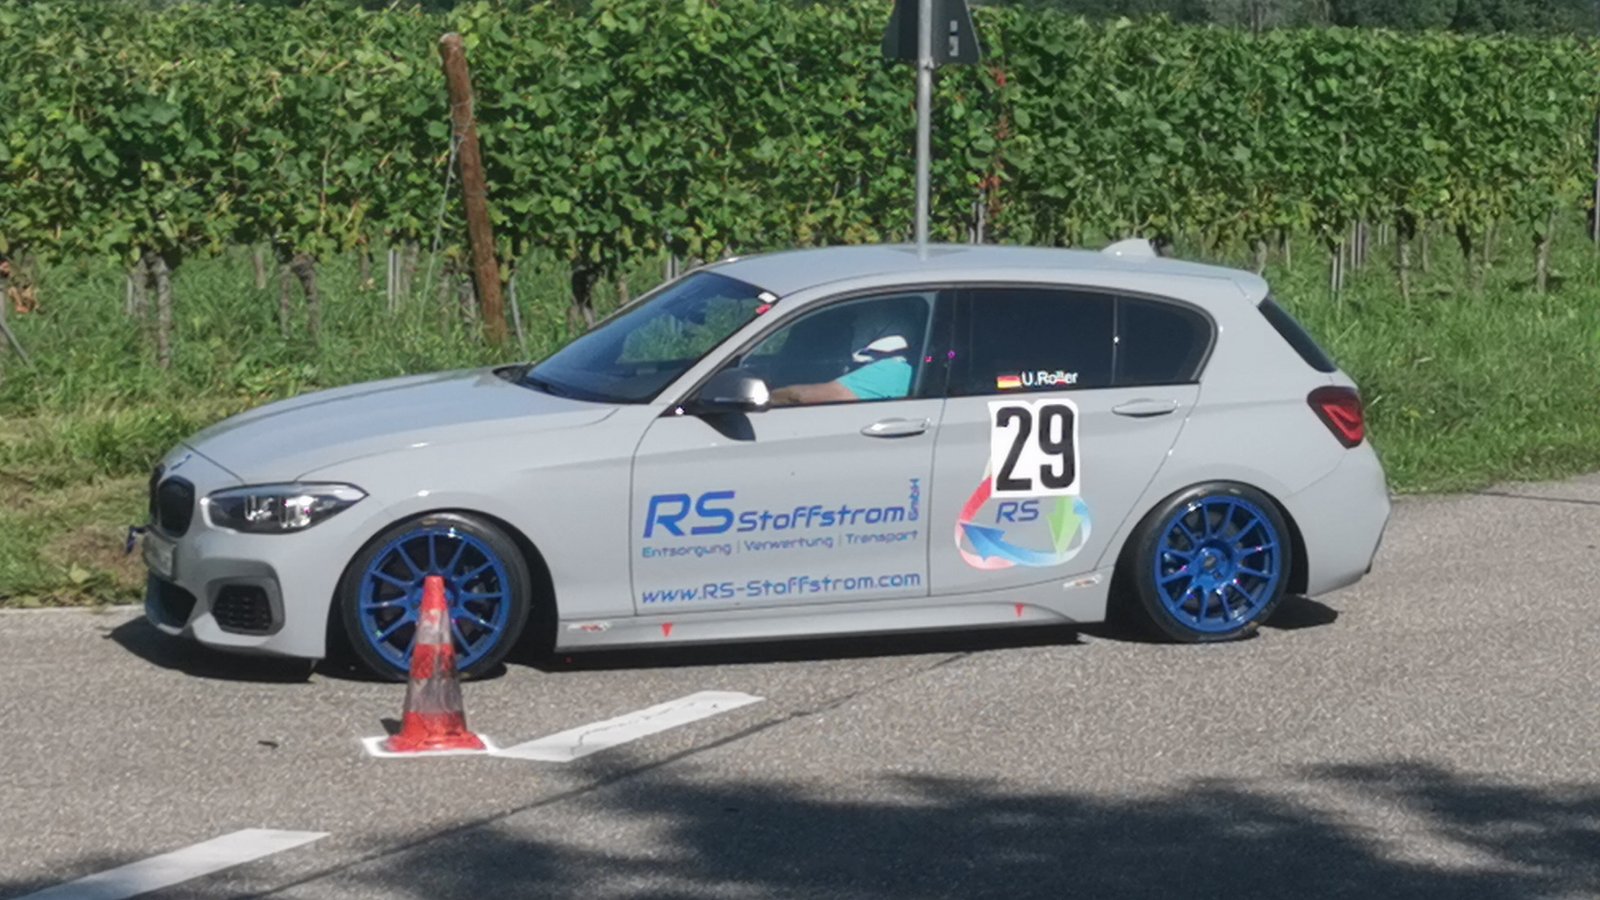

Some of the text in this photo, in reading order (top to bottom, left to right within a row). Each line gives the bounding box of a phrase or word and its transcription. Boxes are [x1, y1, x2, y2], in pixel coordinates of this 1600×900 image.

[996, 404, 1075, 491] 29
[644, 490, 904, 537] RS Stoffstrom
[996, 501, 1039, 523] RS
[642, 543, 731, 559] Entsorgung
[744, 535, 833, 551] Verwertung
[642, 572, 920, 604] www.RS-Stoffstrom.com
